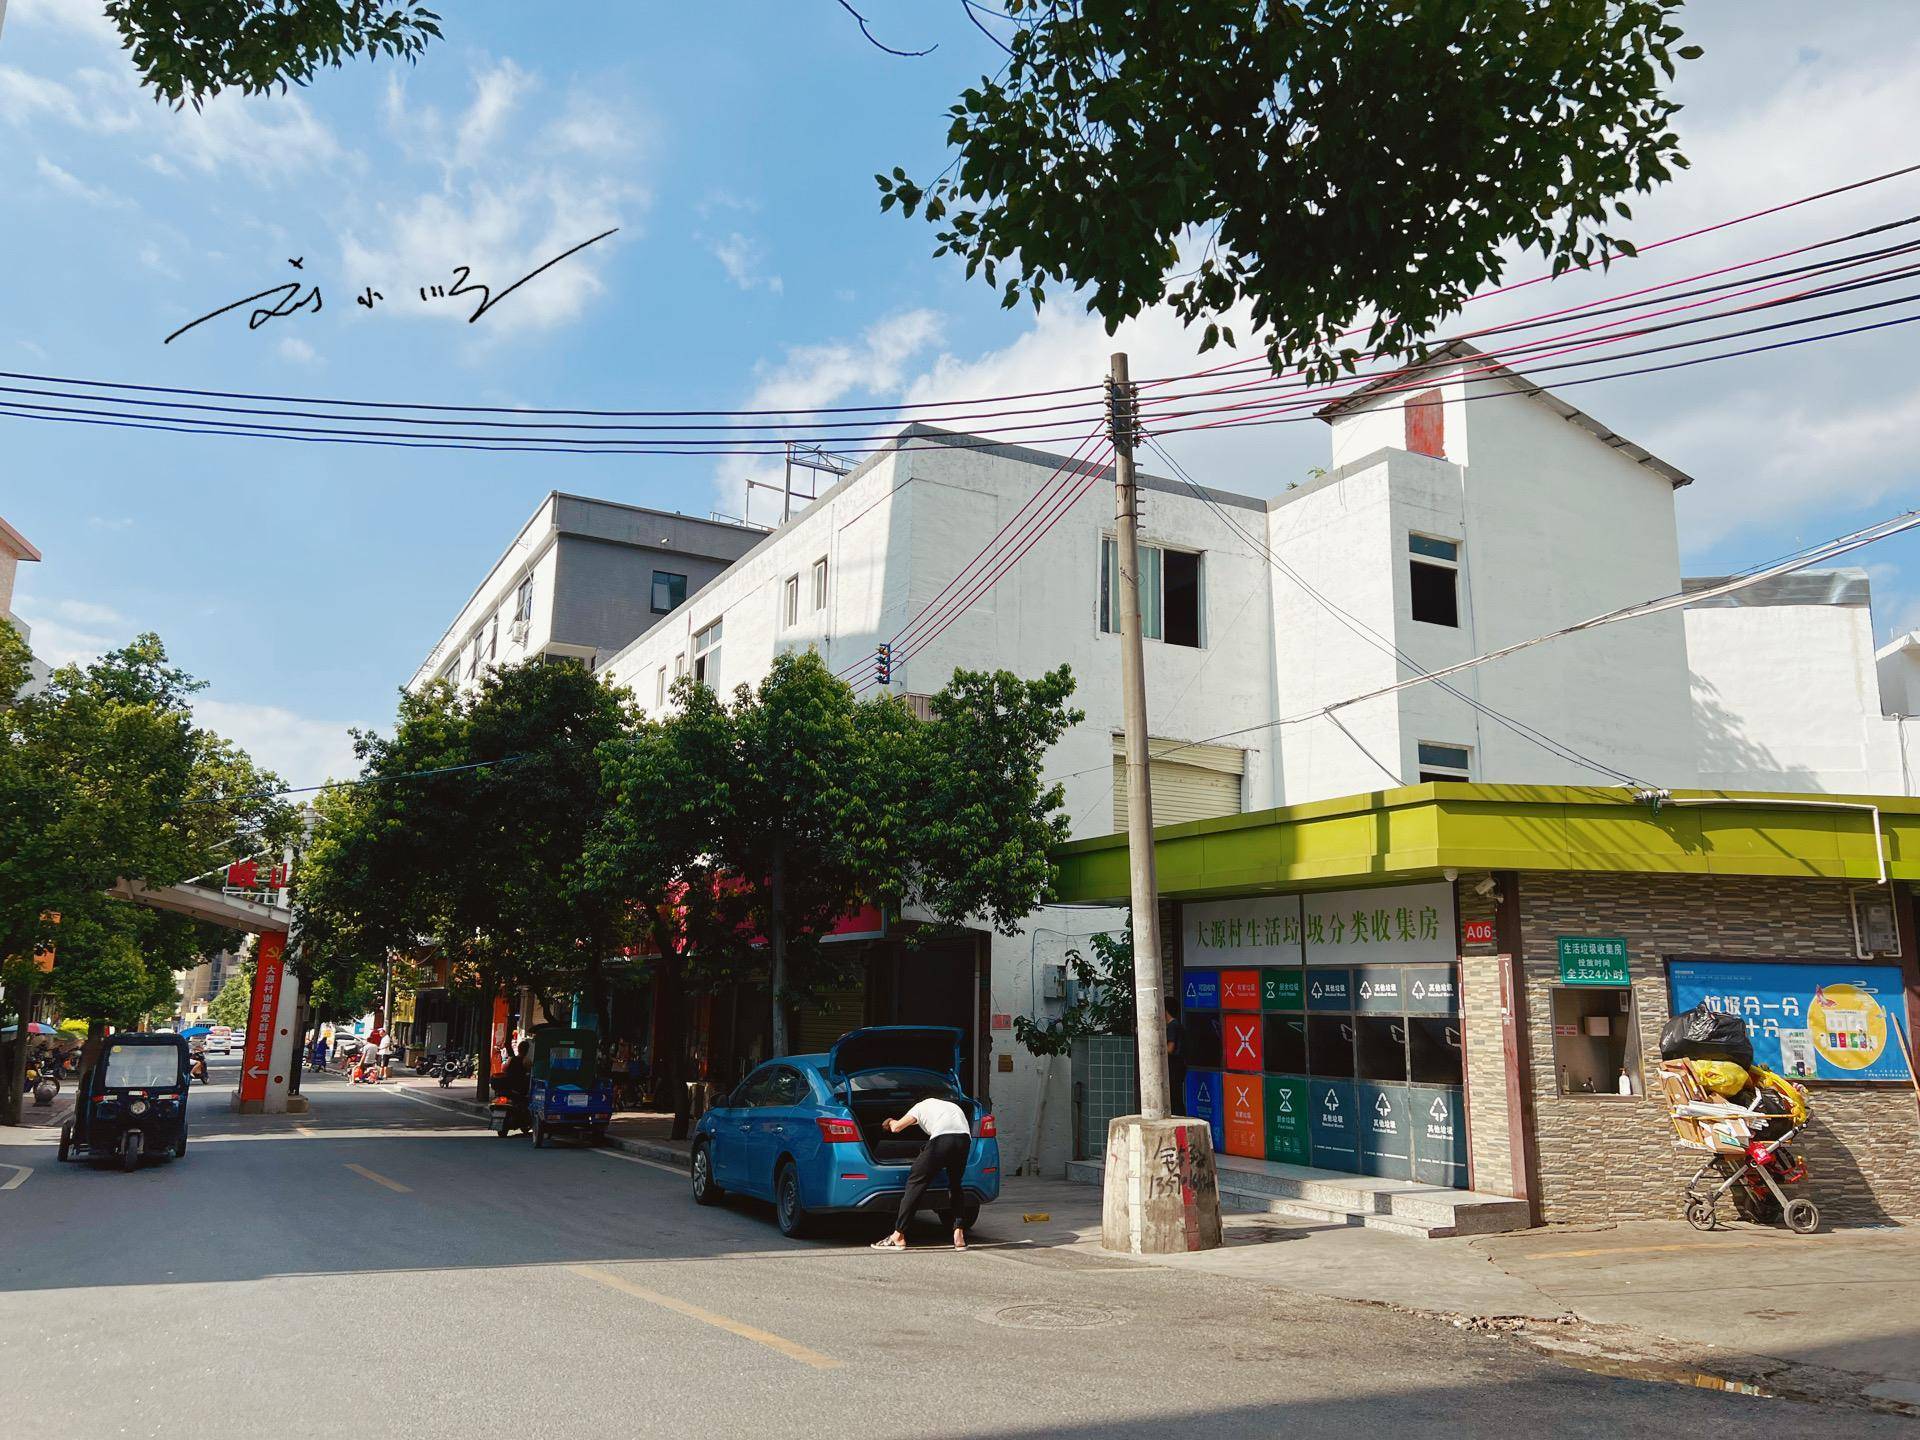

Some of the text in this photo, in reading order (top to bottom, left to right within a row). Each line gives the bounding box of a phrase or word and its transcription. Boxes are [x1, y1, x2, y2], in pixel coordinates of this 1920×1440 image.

[1195, 905, 1440, 949] 大源村生活垃圾分类收集房
[1466, 924, 1492, 939] A06
[1564, 943, 1622, 956] 生活垃圾收集房
[1578, 958, 1611, 968] 投放时间
[1566, 968, 1624, 980] 全天24小时
[1704, 994, 1799, 1016] 垃圾分一分
[254, 964, 277, 1062] 大源村谢屋党群服务站
